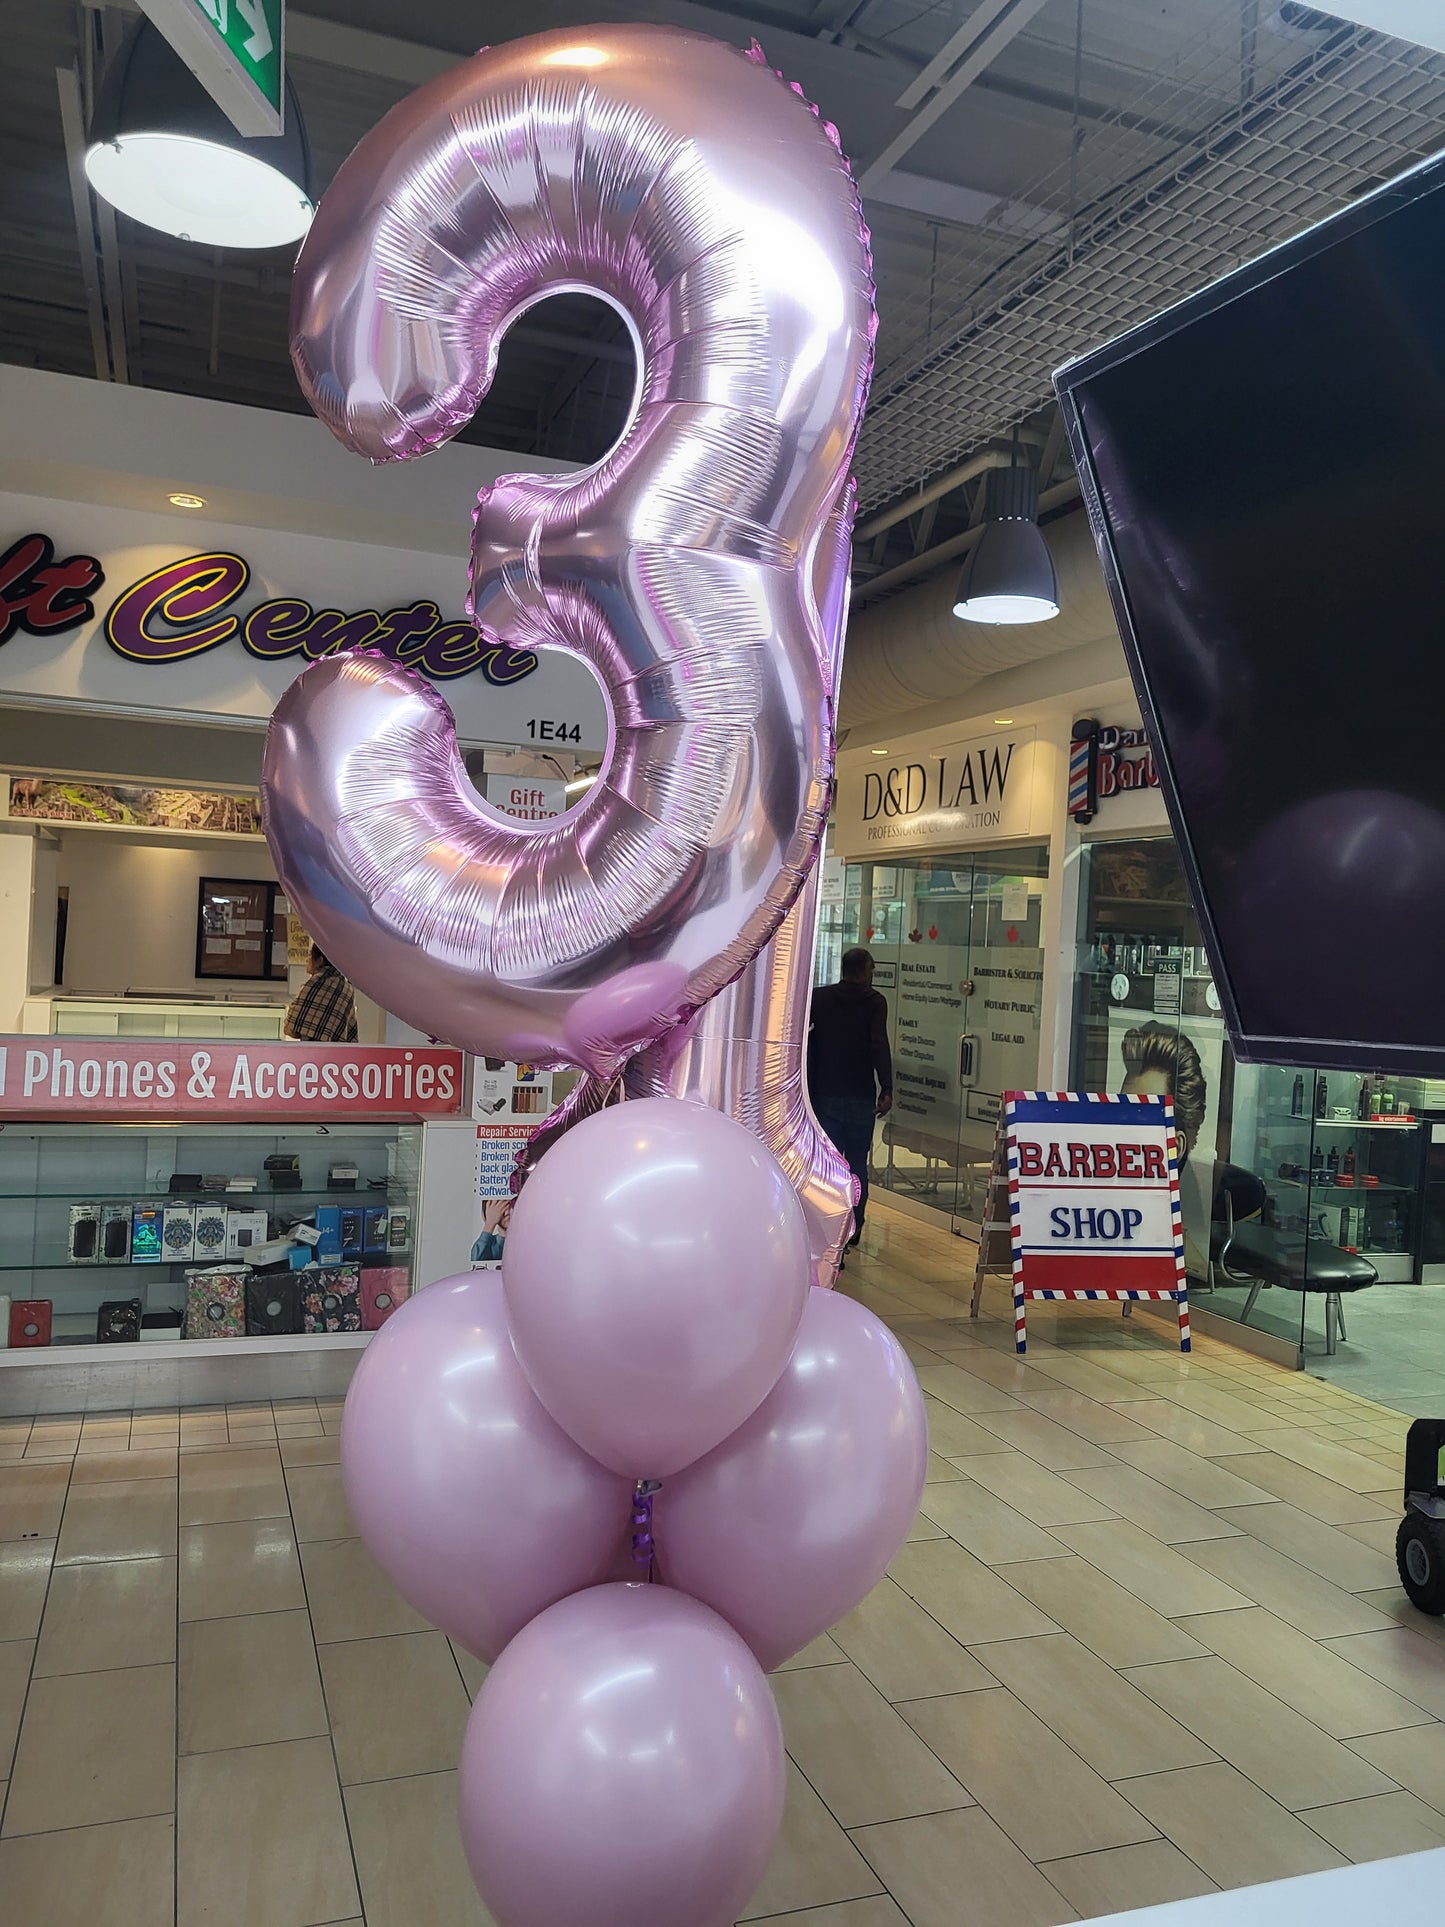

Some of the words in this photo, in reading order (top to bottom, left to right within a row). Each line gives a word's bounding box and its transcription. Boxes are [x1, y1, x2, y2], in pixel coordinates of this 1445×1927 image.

[104, 551, 538, 686] Center
[527, 719, 582, 743] 1E44
[862, 764, 926, 821] D&D
[938, 743, 1016, 810] LAW
[510, 789, 545, 807] Gift
[928, 810, 1001, 834] COORATION
[916, 964, 936, 973] ESTATE
[1007, 968, 1013, 979] &
[1158, 963, 1176, 973] PASS
[992, 1032, 1011, 1042] LEGAL
[1012, 1033, 1025, 1044] AID
[24, 1048, 176, 1098] Phones
[186, 1052, 216, 1098] &
[228, 1052, 454, 1099] Accessories
[480, 1126, 508, 1139] Repair
[481, 1140, 510, 1150] Broken
[481, 1152, 510, 1161] Broken
[1017, 1142, 1168, 1179] BARBER
[480, 1163, 500, 1173] back
[480, 1175, 509, 1186] Battery
[1050, 1207, 1143, 1239] SHOP
